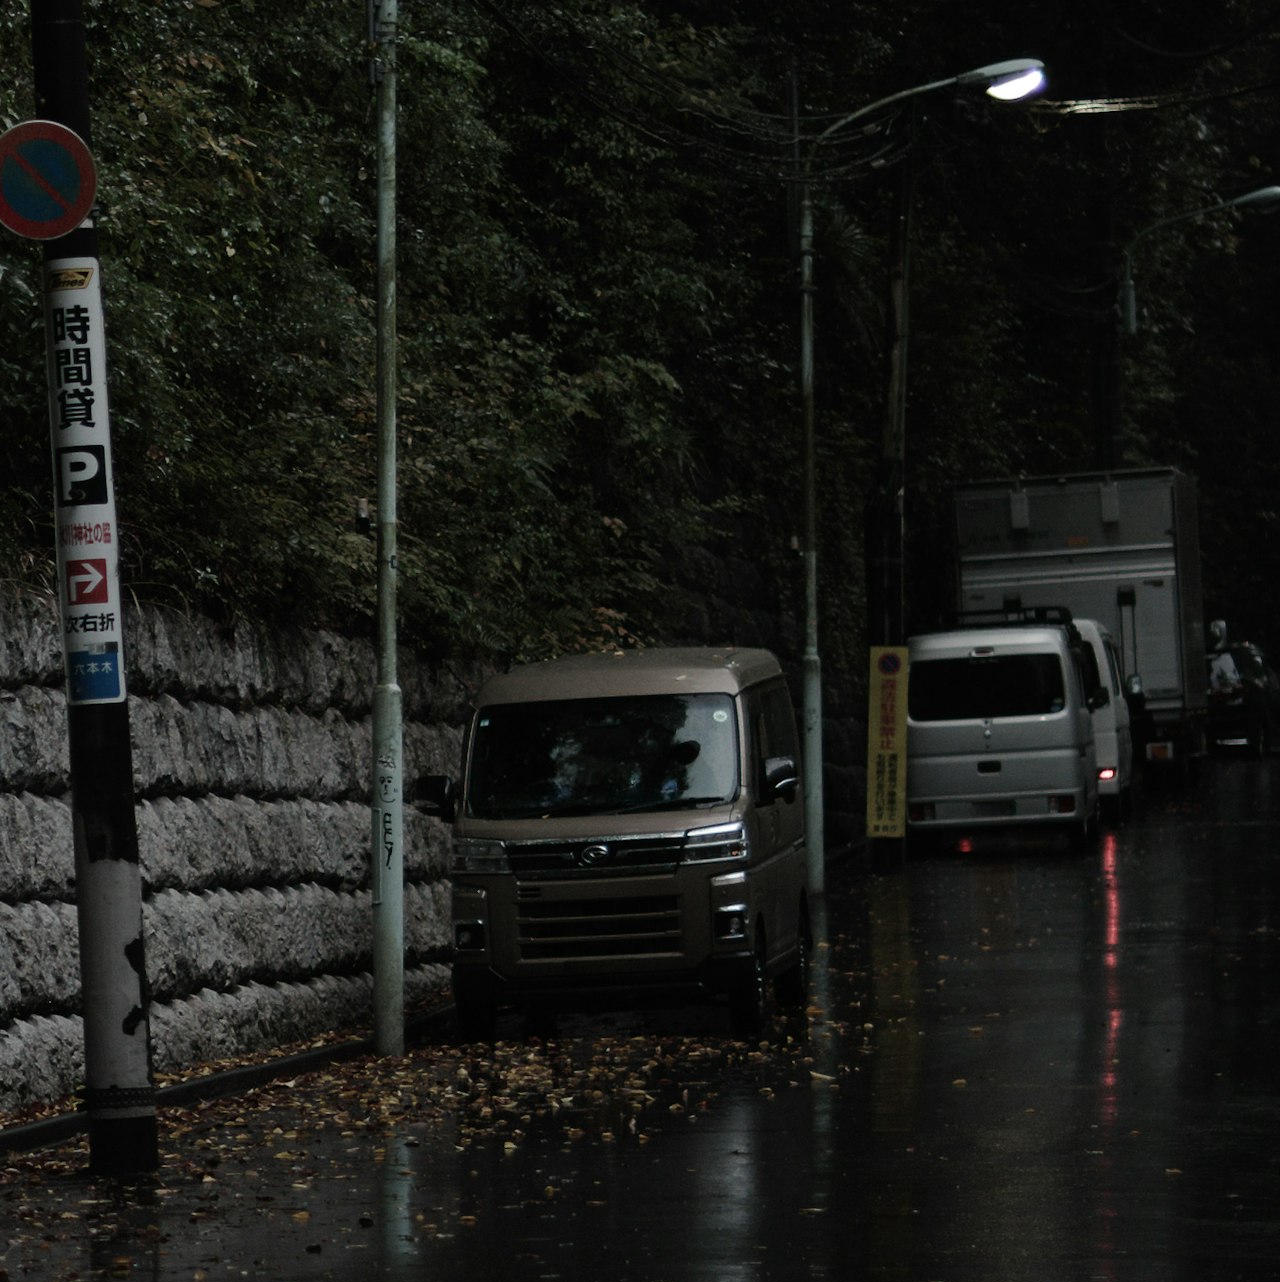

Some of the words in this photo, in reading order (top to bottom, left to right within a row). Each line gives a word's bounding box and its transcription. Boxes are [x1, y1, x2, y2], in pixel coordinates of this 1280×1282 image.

[53, 305, 96, 430] 時間貸
[60, 450, 99, 501] P
[65, 612, 115, 634] 次右折
[73, 661, 113, 676] 六本木
